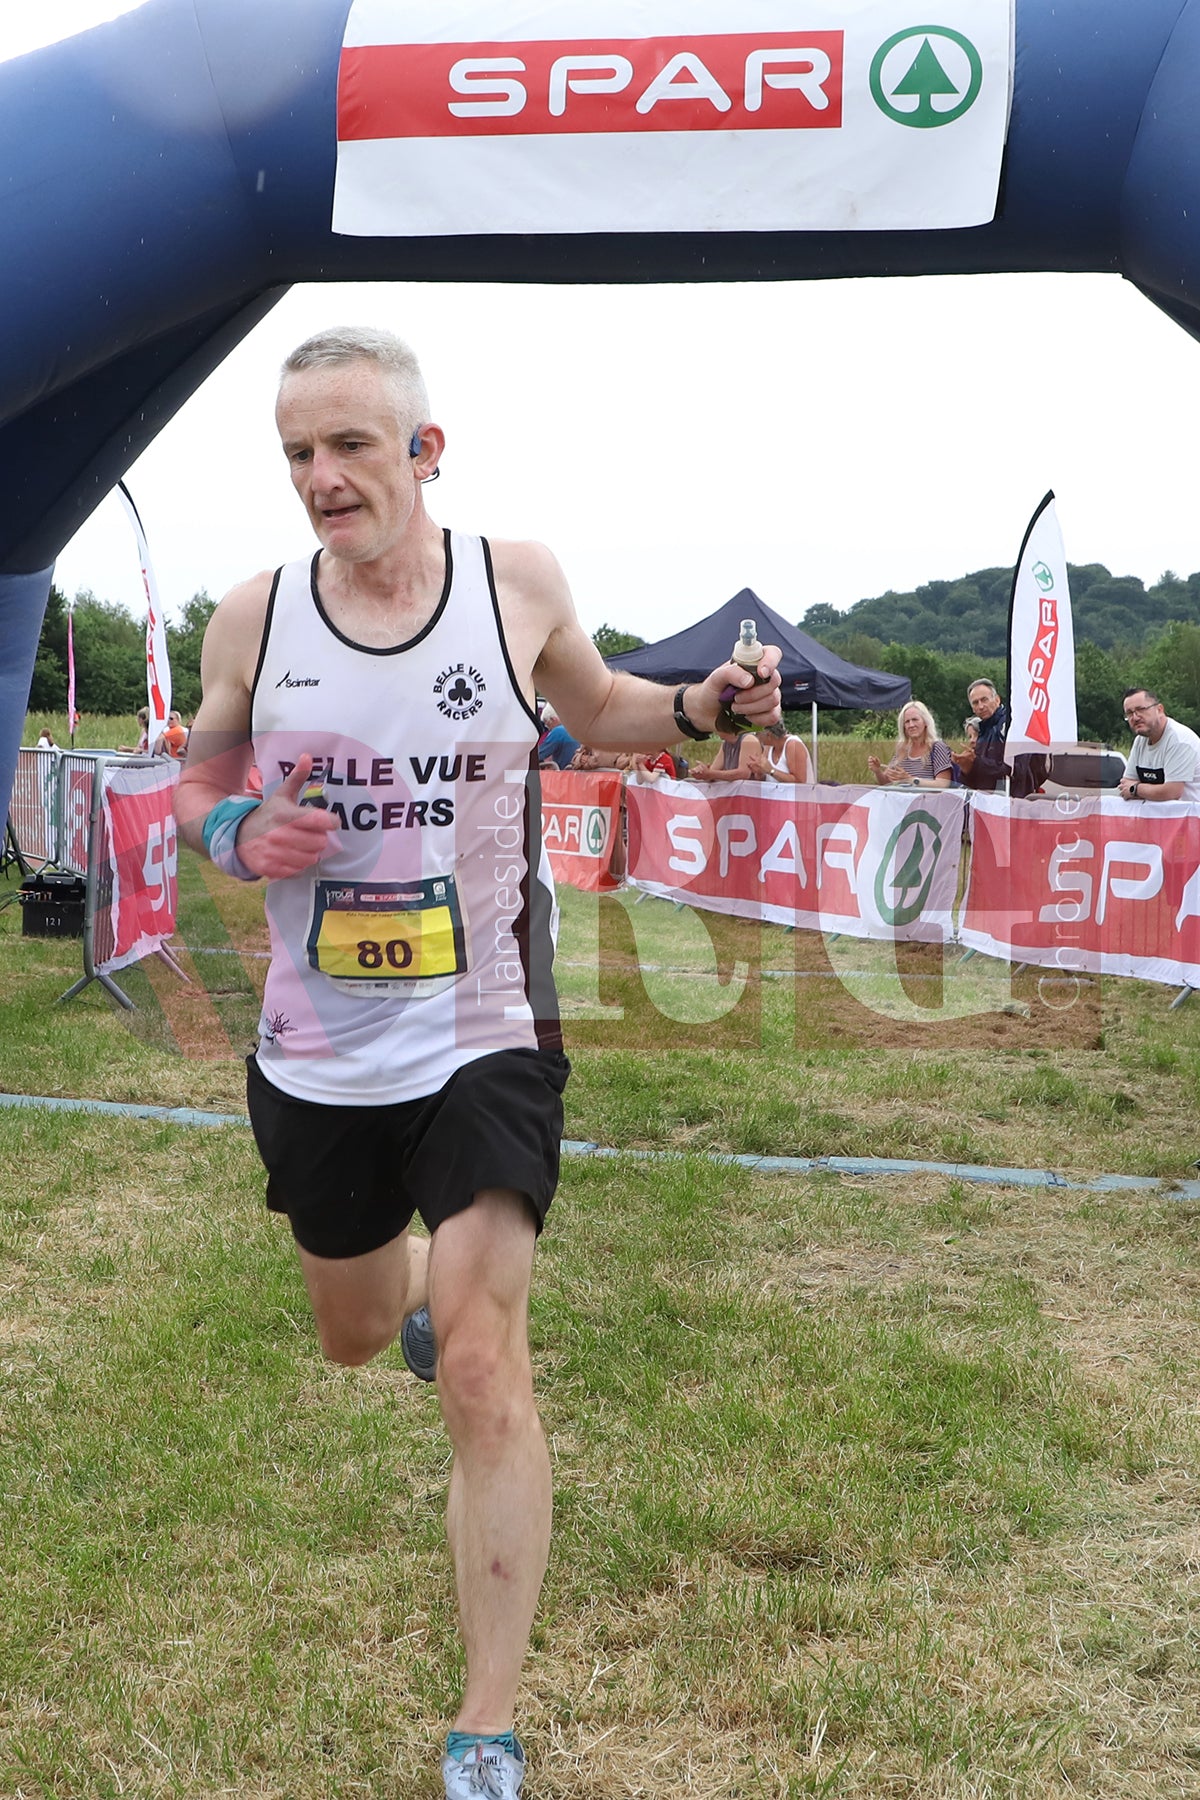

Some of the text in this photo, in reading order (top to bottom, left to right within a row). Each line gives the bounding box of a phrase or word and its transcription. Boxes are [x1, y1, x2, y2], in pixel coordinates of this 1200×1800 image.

[448, 47, 830, 118] SPAR
[1031, 601, 1056, 713] SPAR
[285, 677, 321, 688] Scimitar
[433, 663, 487, 693] BELLE VUE
[437, 699, 484, 720] RACERS
[409, 754, 487, 785] VUE
[300, 797, 456, 831] ACERS
[666, 814, 858, 894] SPAR
[45, 917, 61, 926] 121
[357, 939, 413, 969] 80
